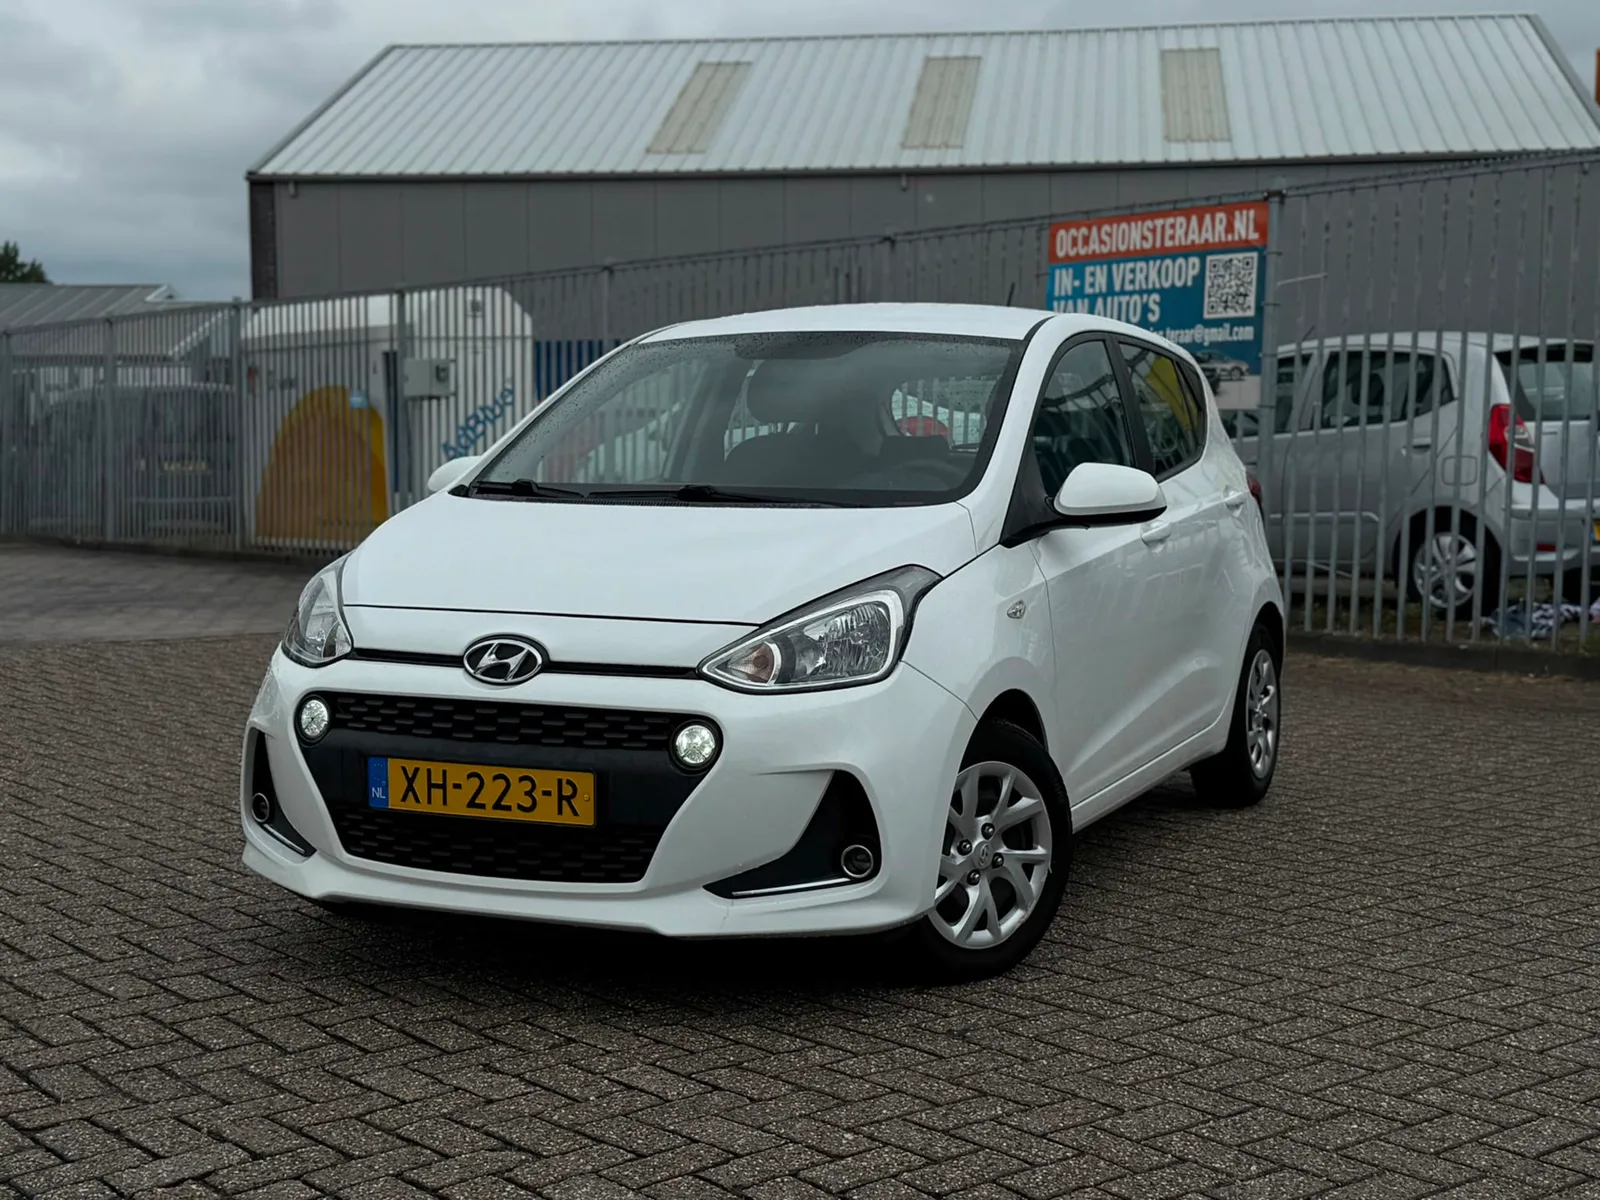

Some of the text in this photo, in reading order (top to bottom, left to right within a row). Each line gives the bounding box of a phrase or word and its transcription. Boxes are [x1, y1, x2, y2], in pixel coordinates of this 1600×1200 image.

[1056, 209, 1259, 258] OCCASIONSTERAAR.NL
[1053, 256, 1199, 297] IN- EN VERKOOP
[1095, 294, 1160, 323] AUTO'S
[371, 786, 386, 800] NL
[400, 765, 580, 817] XH-223-R
